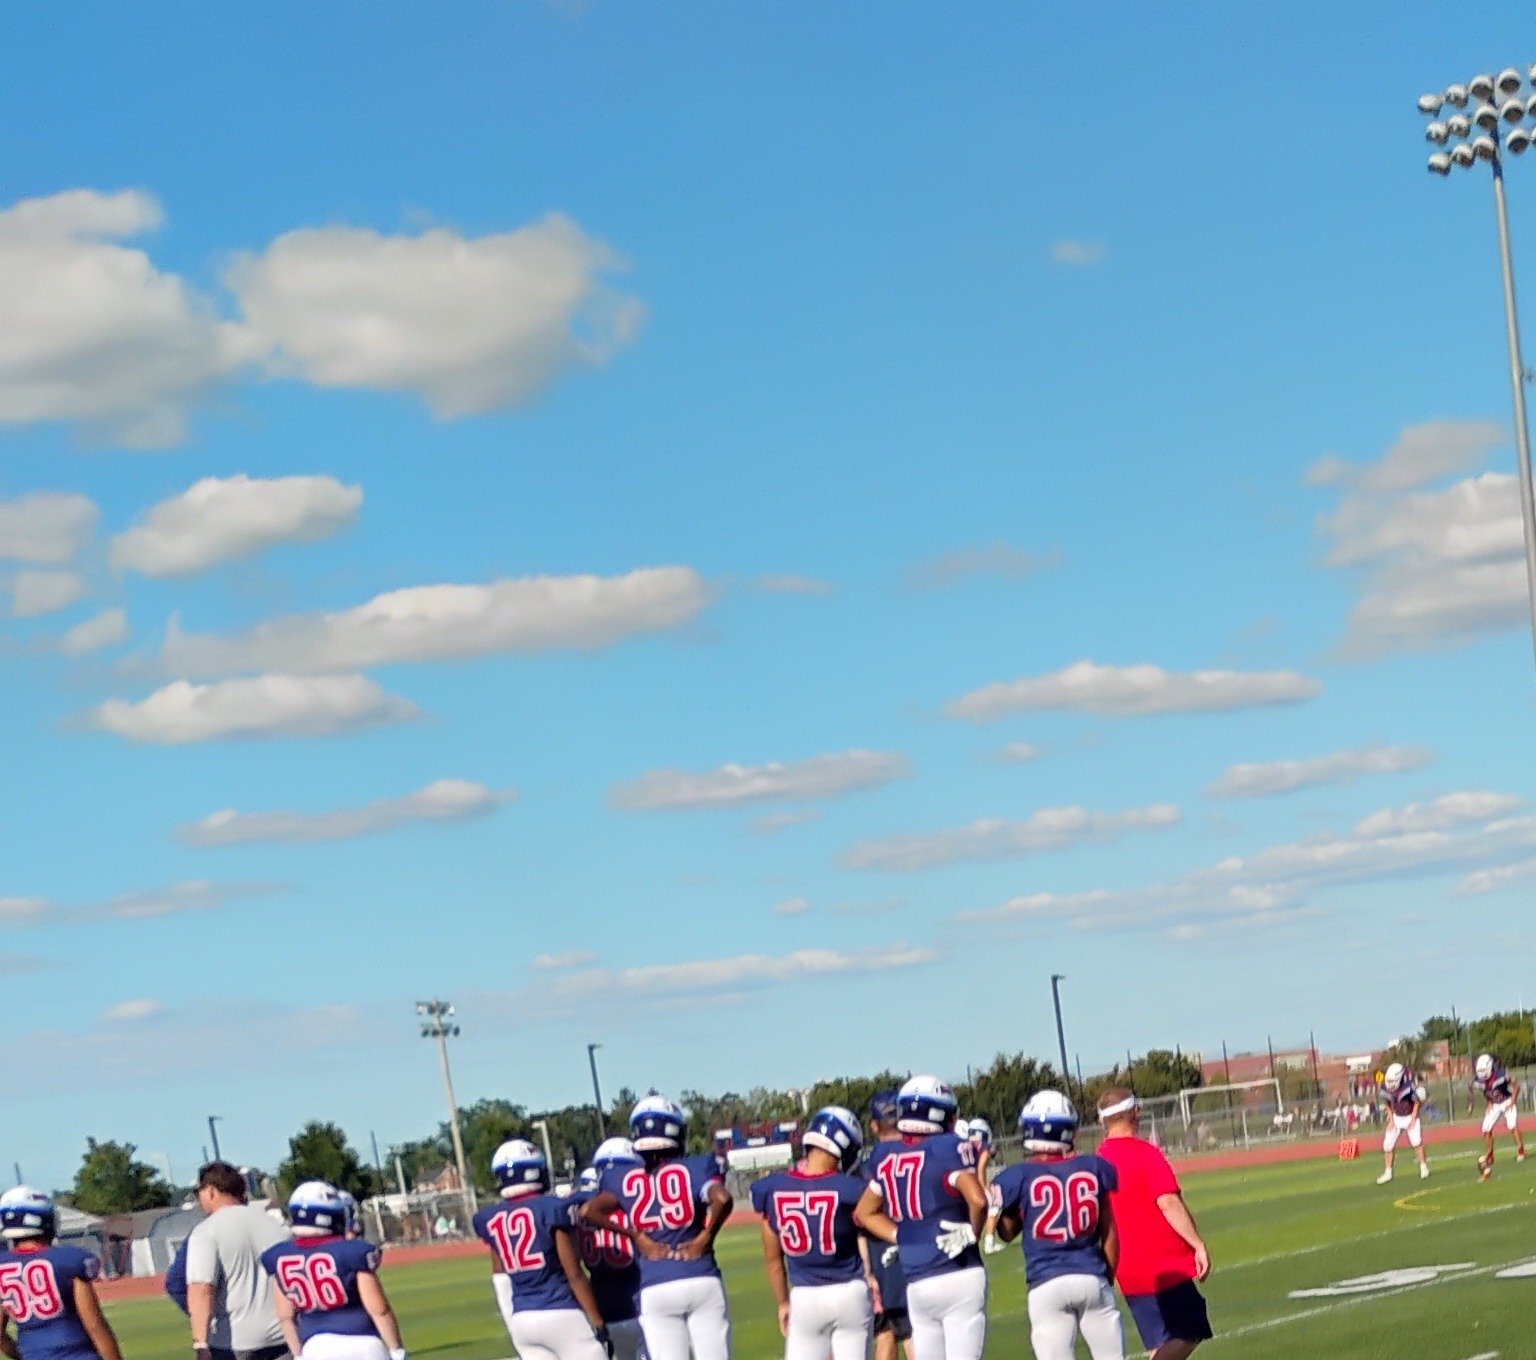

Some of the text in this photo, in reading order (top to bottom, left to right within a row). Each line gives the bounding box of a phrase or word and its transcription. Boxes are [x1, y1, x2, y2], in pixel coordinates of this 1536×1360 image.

[623, 1164, 695, 1232] 29
[877, 1151, 925, 1222] 17
[1030, 1171, 1099, 1242] 26
[487, 1207, 545, 1273] 12
[773, 1191, 839, 1257] 57
[0, 1259, 63, 1323] 59
[277, 1252, 348, 1313] 56
